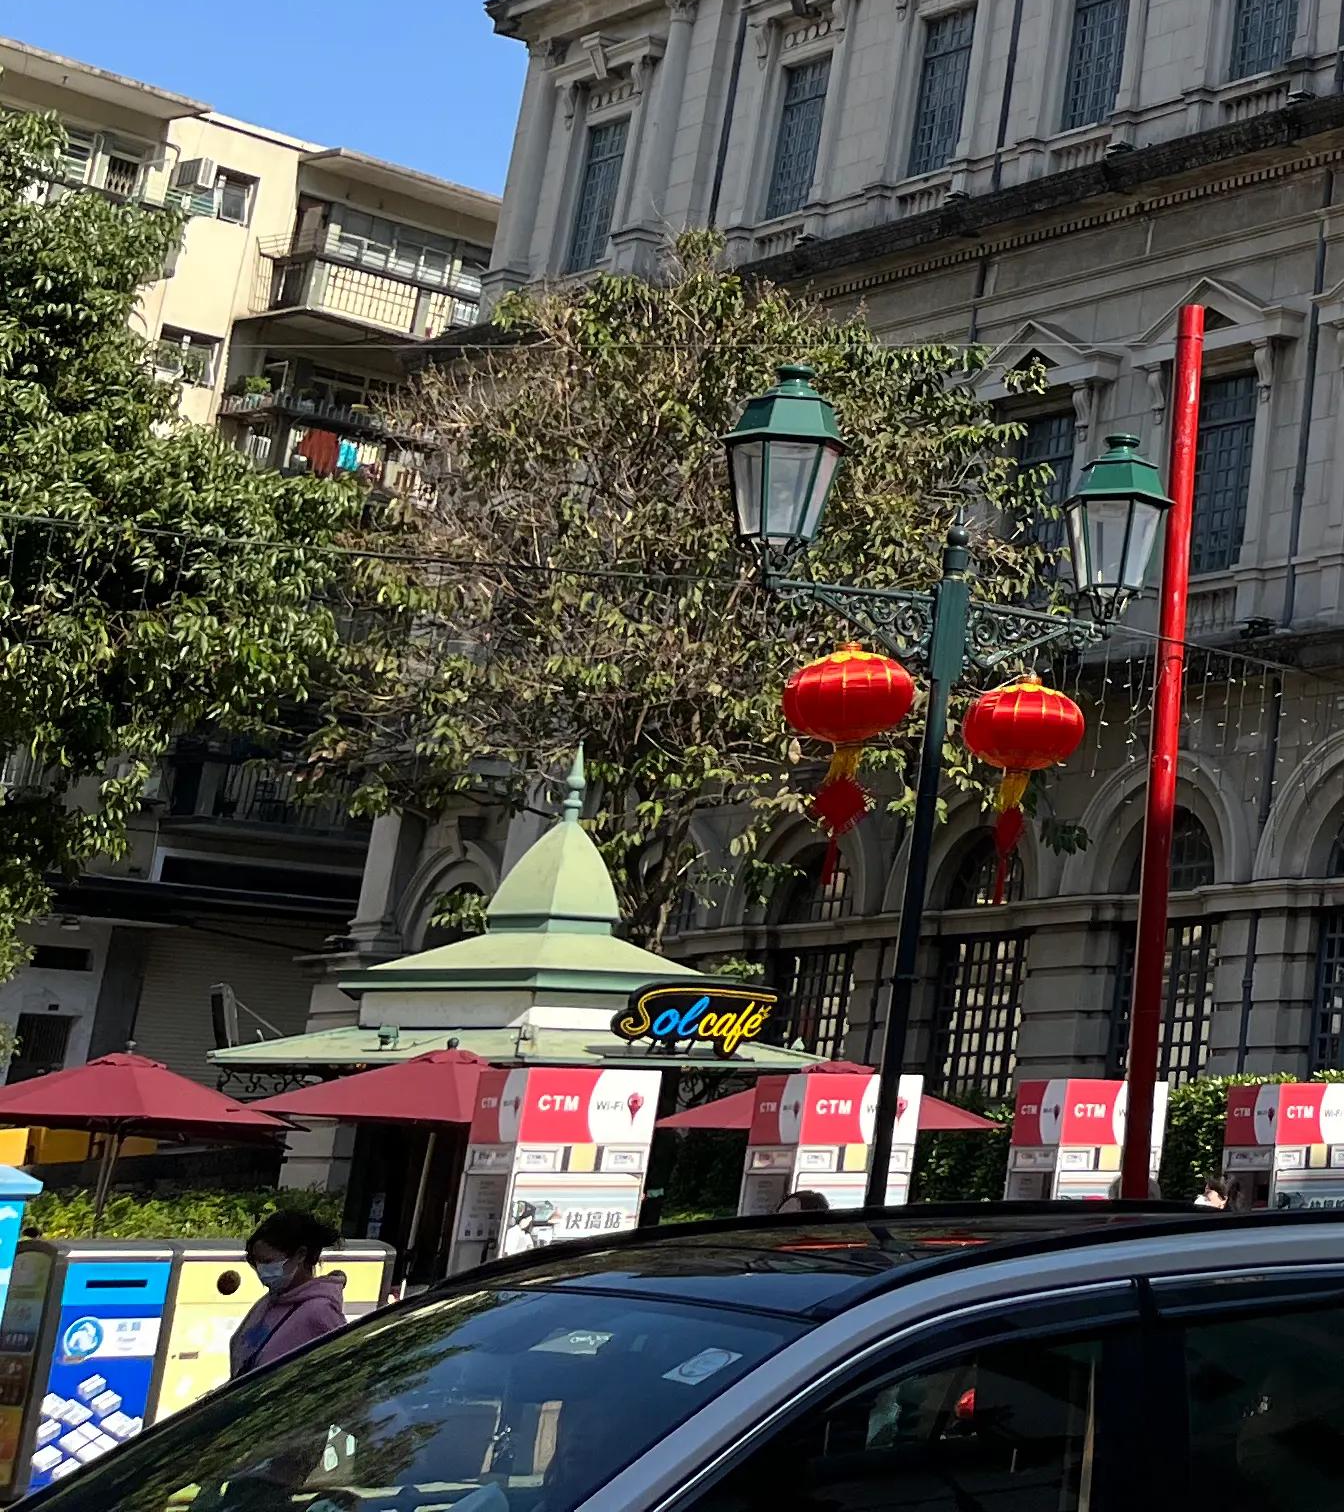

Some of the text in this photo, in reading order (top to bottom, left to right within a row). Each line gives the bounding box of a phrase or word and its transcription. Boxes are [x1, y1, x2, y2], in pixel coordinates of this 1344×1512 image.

[537, 1093, 580, 1113] CTM
[596, 1100, 624, 1111] Wi-Fi
[759, 1101, 777, 1114] CTM
[815, 1099, 853, 1116] CTM
[1073, 1103, 1107, 1119] CTM
[1233, 1107, 1251, 1117] CTM
[1286, 1105, 1314, 1120] CTM
